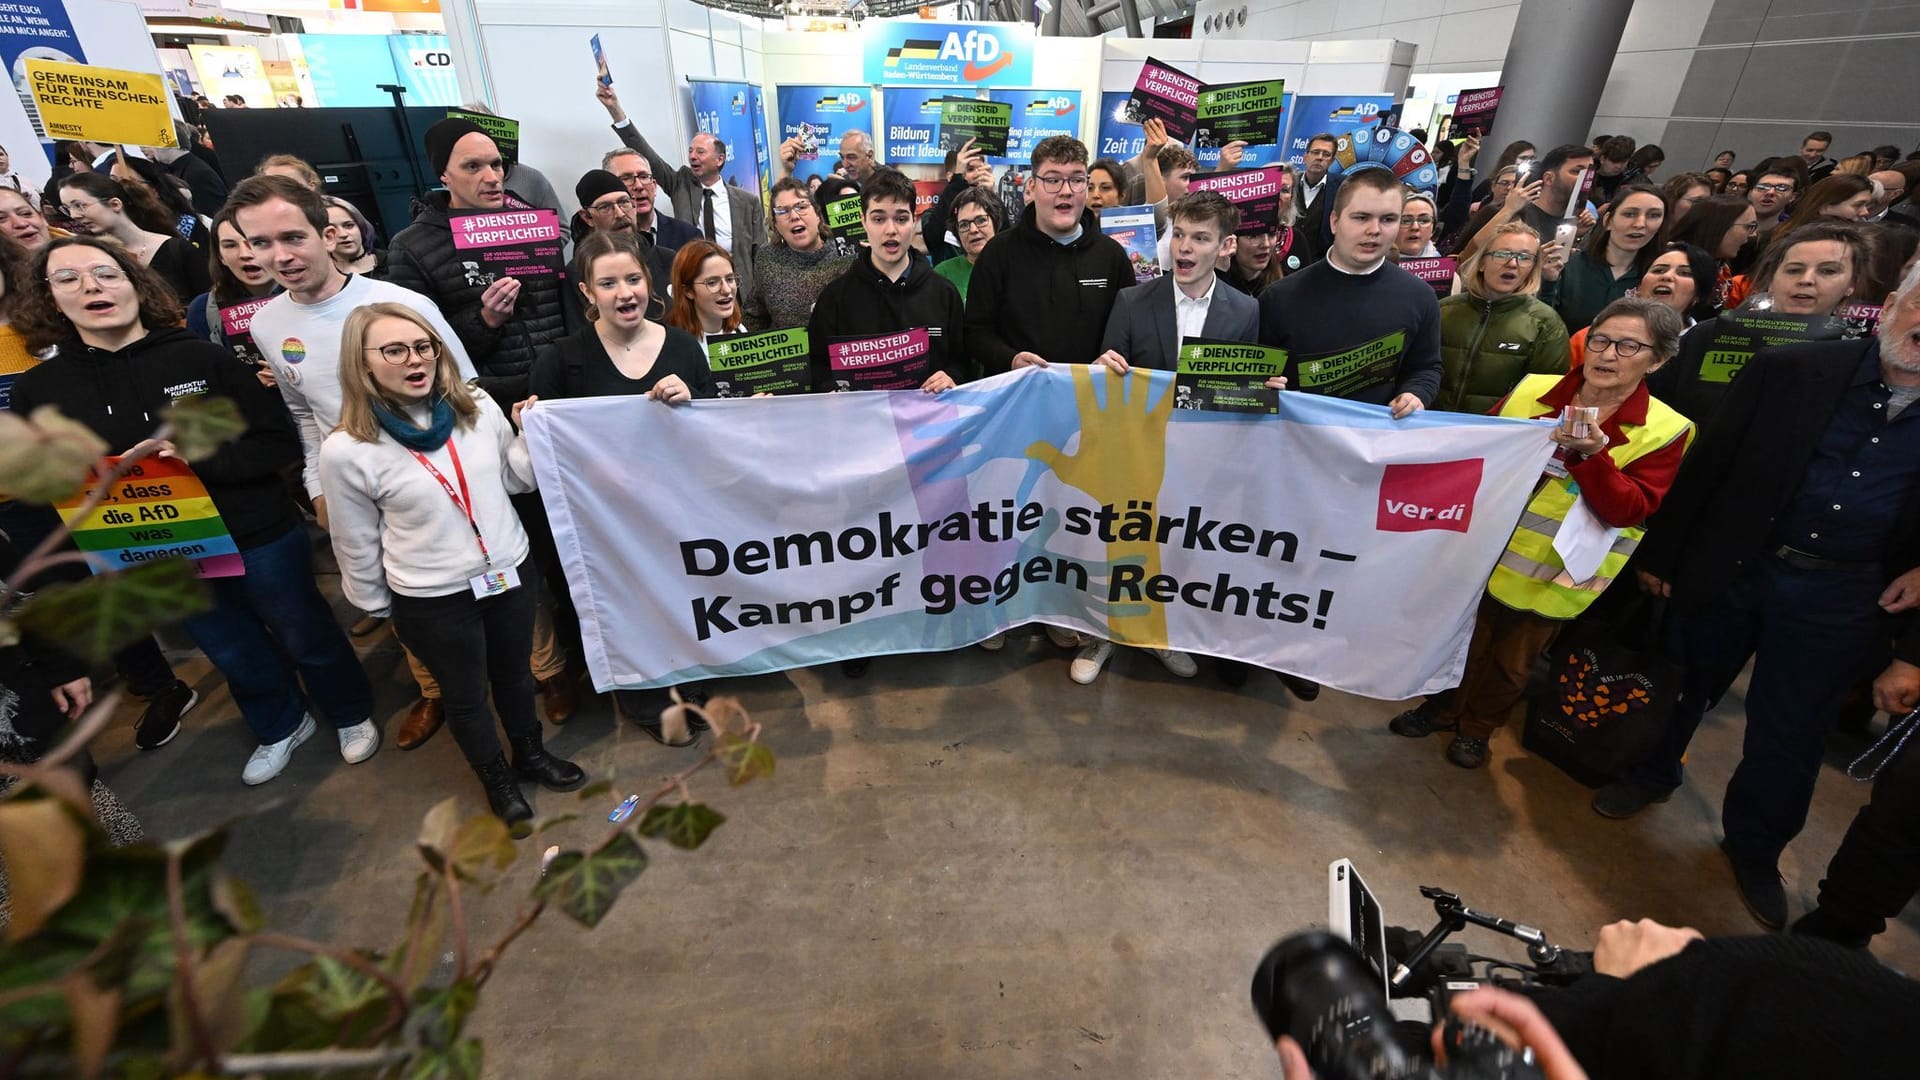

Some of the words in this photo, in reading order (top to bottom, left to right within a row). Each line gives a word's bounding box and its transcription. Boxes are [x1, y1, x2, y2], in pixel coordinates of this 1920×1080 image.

[19, 5, 41, 15] EUCH
[0, 14, 10, 23] LE
[11, 16, 26, 25] AN,
[25, 16, 50, 26] WENN
[16, 26, 38, 36] MICH
[38, 28, 71, 39] ANGEHT.
[940, 30, 1000, 62] AfD
[426, 52, 453, 67] CD
[904, 62, 958, 71] Landesverband
[33, 70, 129, 91] GEMEINSAM
[884, 70, 958, 82] Baden-Württemberg
[36, 82, 69, 96] FÜR
[74, 86, 164, 105] MENSCHEN-
[40, 93, 104, 111] RECHTE
[838, 94, 861, 107] AfD
[1145, 80, 1199, 106] VERPFLICHTE
[1206, 86, 1267, 105] #DIENSTEID
[948, 104, 998, 114] #DIENSTEID
[1048, 96, 1070, 109] AfD
[1204, 96, 1277, 116] VERPFLICHTET!
[1354, 104, 1379, 116] AfD
[49, 122, 82, 132] AMNESTY
[947, 114, 1007, 126] VERPFLICHTET!
[890, 126, 930, 144] Bildung
[890, 144, 917, 157] statt
[1102, 137, 1128, 154] Zeit
[1131, 138, 1145, 154] fü
[1290, 155, 1305, 165] sta
[1198, 172, 1265, 192] #DIENSTEID
[1219, 182, 1276, 200] PFLICHTET!
[832, 198, 862, 214] #DIENS
[462, 214, 538, 232] #DIENSTEID
[464, 226, 555, 245] VERPFLICHTET!
[228, 302, 268, 320] #DIEN
[718, 333, 789, 356] #DIENSTEID
[838, 335, 910, 356] #DIENSTEID
[1190, 347, 1265, 360] #DIENSTEID
[720, 344, 804, 368] VERPFLICHTET!
[840, 342, 924, 367] VERPFLICHTET!
[1309, 342, 1384, 374] #DIENSTEID
[1188, 361, 1277, 374] VERPFLICHTET!
[1309, 345, 1397, 384] VERPFLICHTET!
[164, 380, 207, 395] KORREKTUR
[171, 386, 203, 398] KUMPEL
[122, 484, 172, 500] dass
[102, 510, 133, 525] die
[140, 504, 180, 522] AfD
[1386, 499, 1466, 521] ver.di
[128, 528, 174, 542] was
[680, 499, 1044, 577] Demokratie
[1065, 500, 1299, 563] stärken
[120, 544, 206, 563] dagegen
[692, 572, 901, 642] Kampf
[920, 556, 1088, 615] gegen
[1108, 564, 1335, 631] Rechts!
